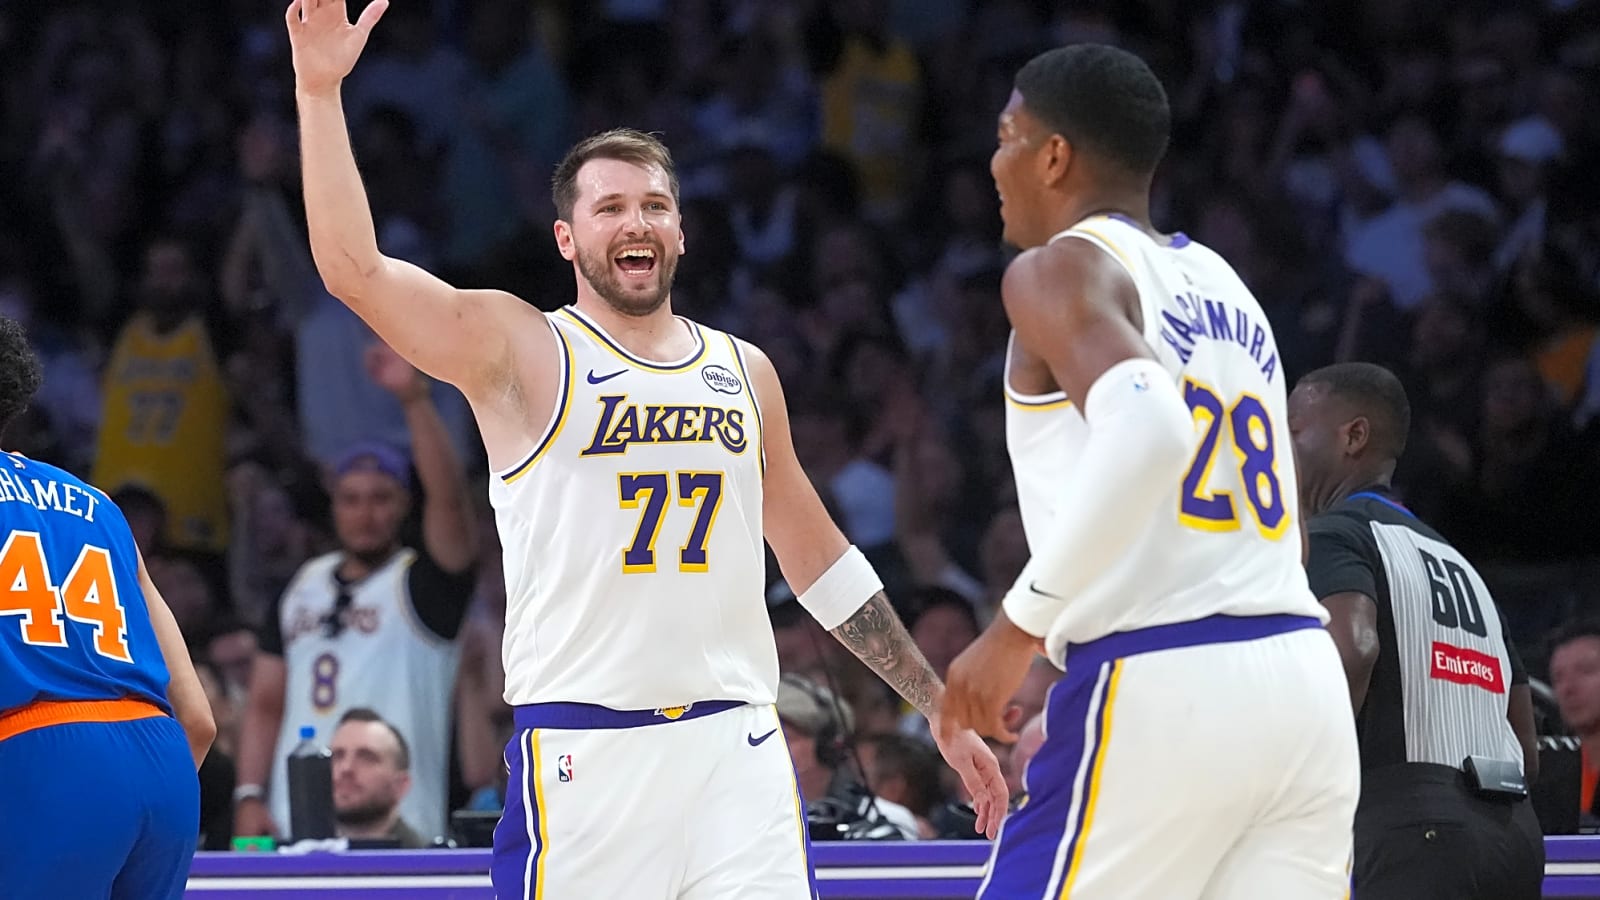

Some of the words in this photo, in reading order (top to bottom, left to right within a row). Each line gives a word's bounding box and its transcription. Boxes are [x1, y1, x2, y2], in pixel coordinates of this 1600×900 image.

[705, 371, 739, 387] bibigo
[579, 394, 748, 458] LAKERS
[1178, 375, 1290, 541] 28
[0, 467, 99, 522] HAMET
[617, 470, 725, 574] 77
[0, 529, 134, 664] 44
[1418, 547, 1487, 639] 60
[312, 653, 339, 714] 8
[1434, 651, 1494, 683] Emirates
